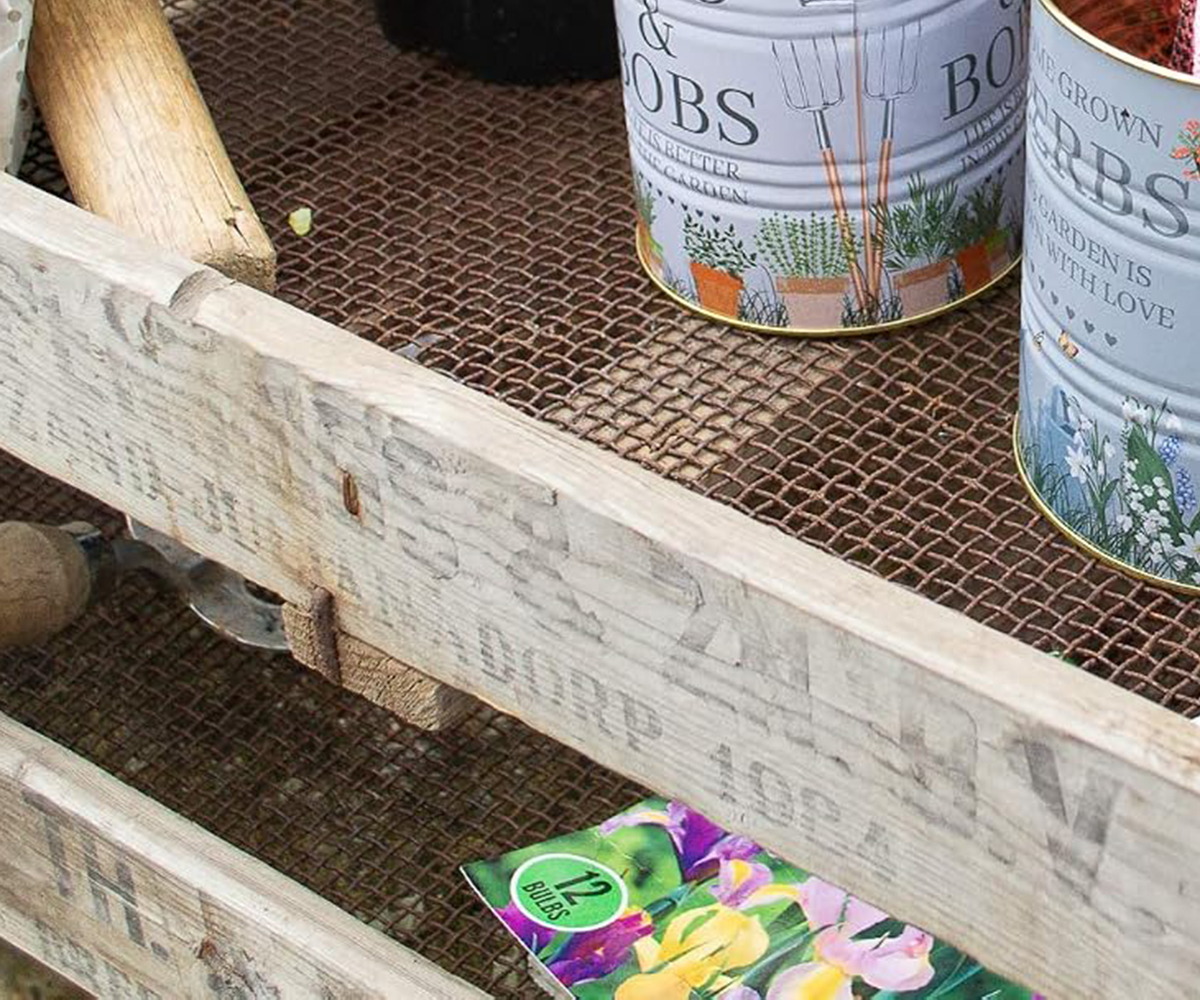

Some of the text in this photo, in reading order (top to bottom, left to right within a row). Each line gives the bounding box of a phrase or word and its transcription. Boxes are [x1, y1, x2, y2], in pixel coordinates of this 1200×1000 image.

[1058, 71, 1164, 149] GROWN
[664, 140, 743, 181] BETTER
[1030, 77, 1190, 239] ERBS
[1038, 194, 1120, 275] GARDEN
[1126, 259, 1152, 288] IS
[1102, 280, 1176, 330] LOVE
[521, 880, 571, 922] BULBS
[554, 869, 613, 907] 12
